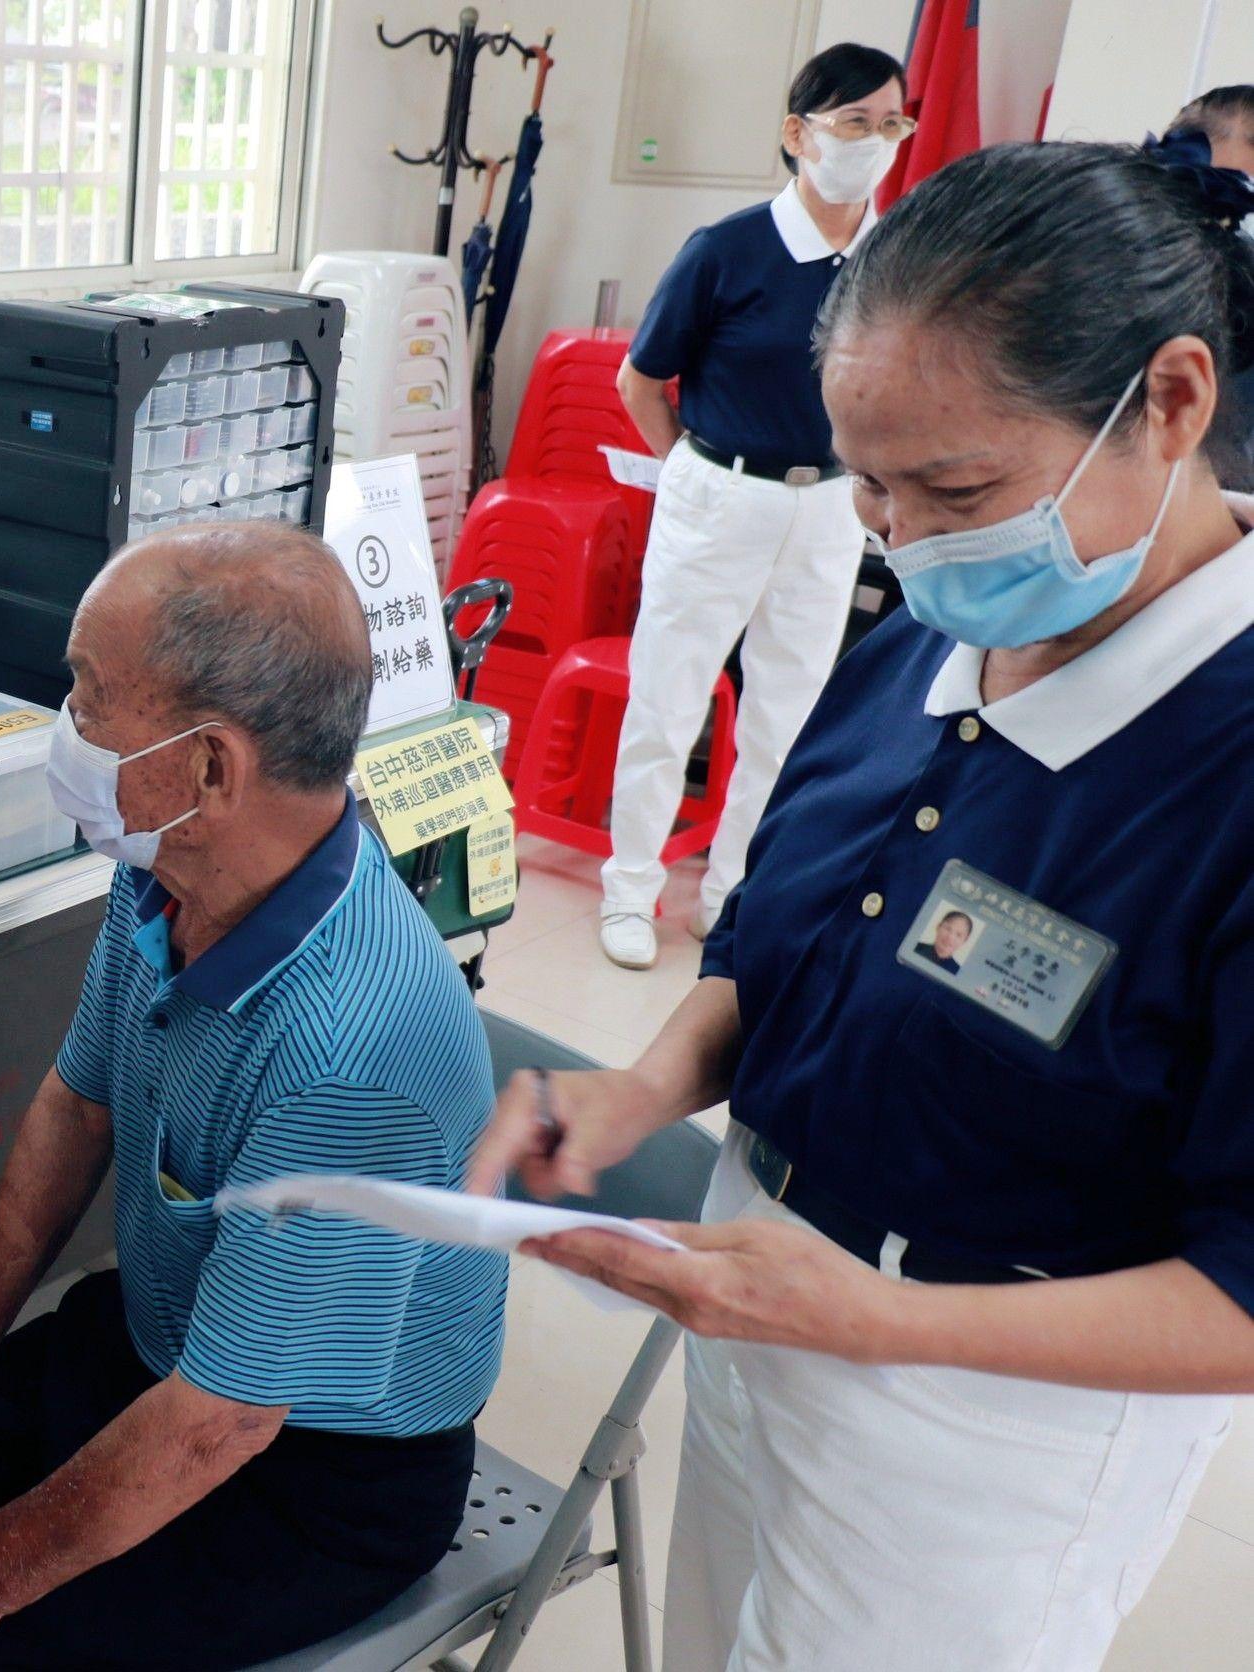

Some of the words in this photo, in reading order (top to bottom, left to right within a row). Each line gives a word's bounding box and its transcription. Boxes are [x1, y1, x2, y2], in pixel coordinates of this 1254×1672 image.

[366, 727, 477, 788] 台中慈濟醫院
[373, 754, 496, 820] 外埔巡迴醫療專用
